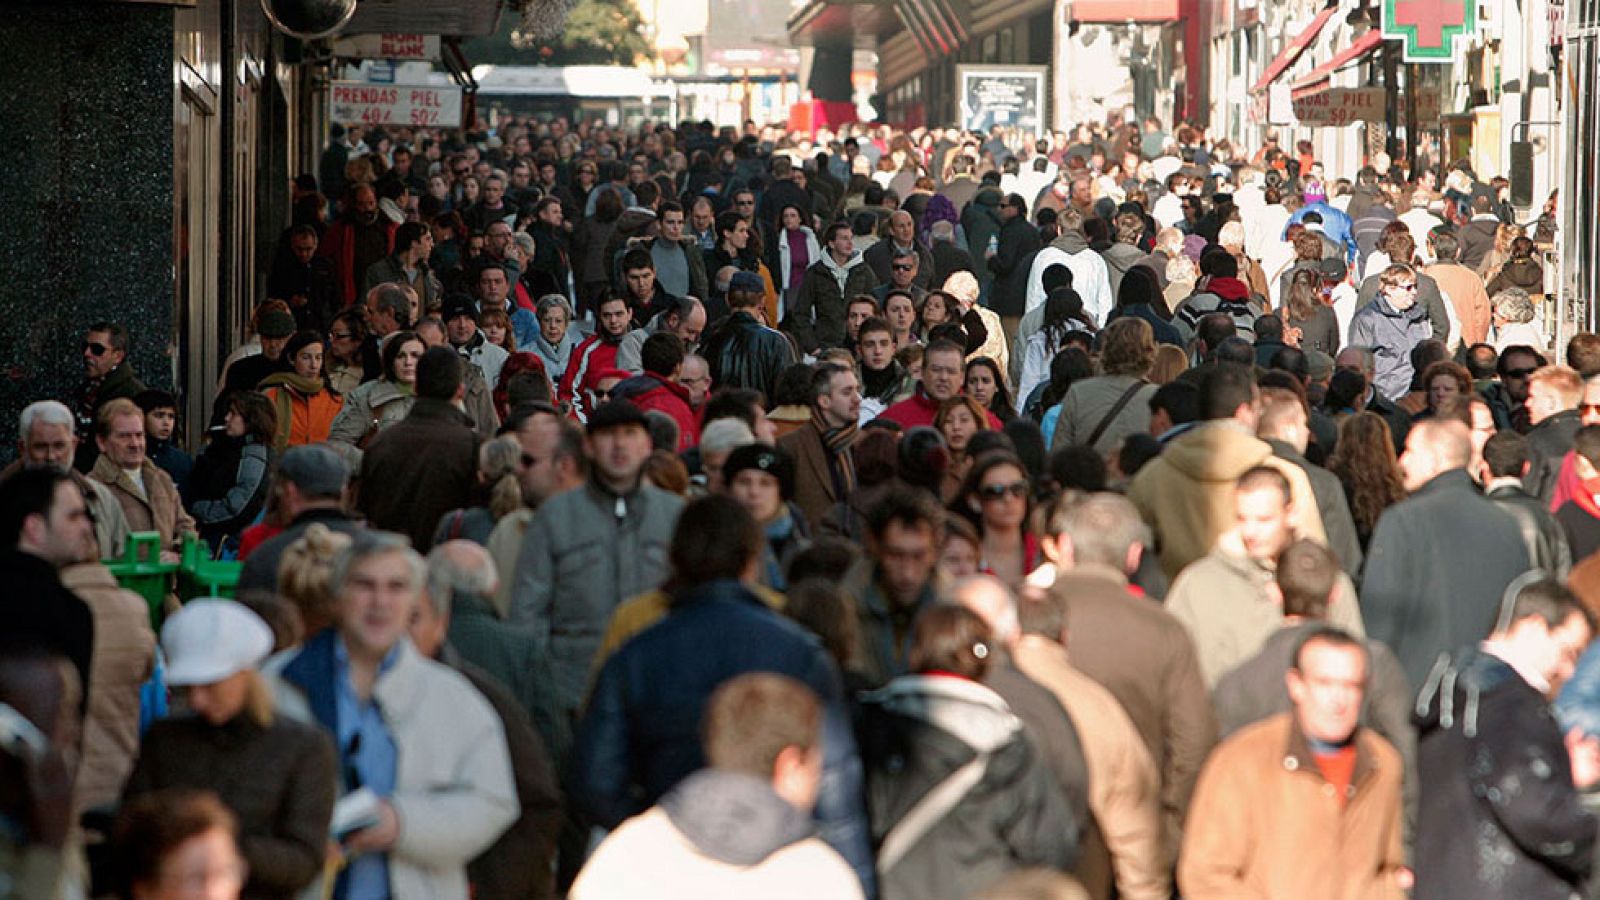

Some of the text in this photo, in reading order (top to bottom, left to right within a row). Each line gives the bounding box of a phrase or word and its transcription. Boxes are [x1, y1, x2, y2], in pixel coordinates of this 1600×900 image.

[381, 43, 424, 56] BLANC
[333, 87, 440, 108] PRENDAS PIEL
[1343, 92, 1372, 106] PIEL
